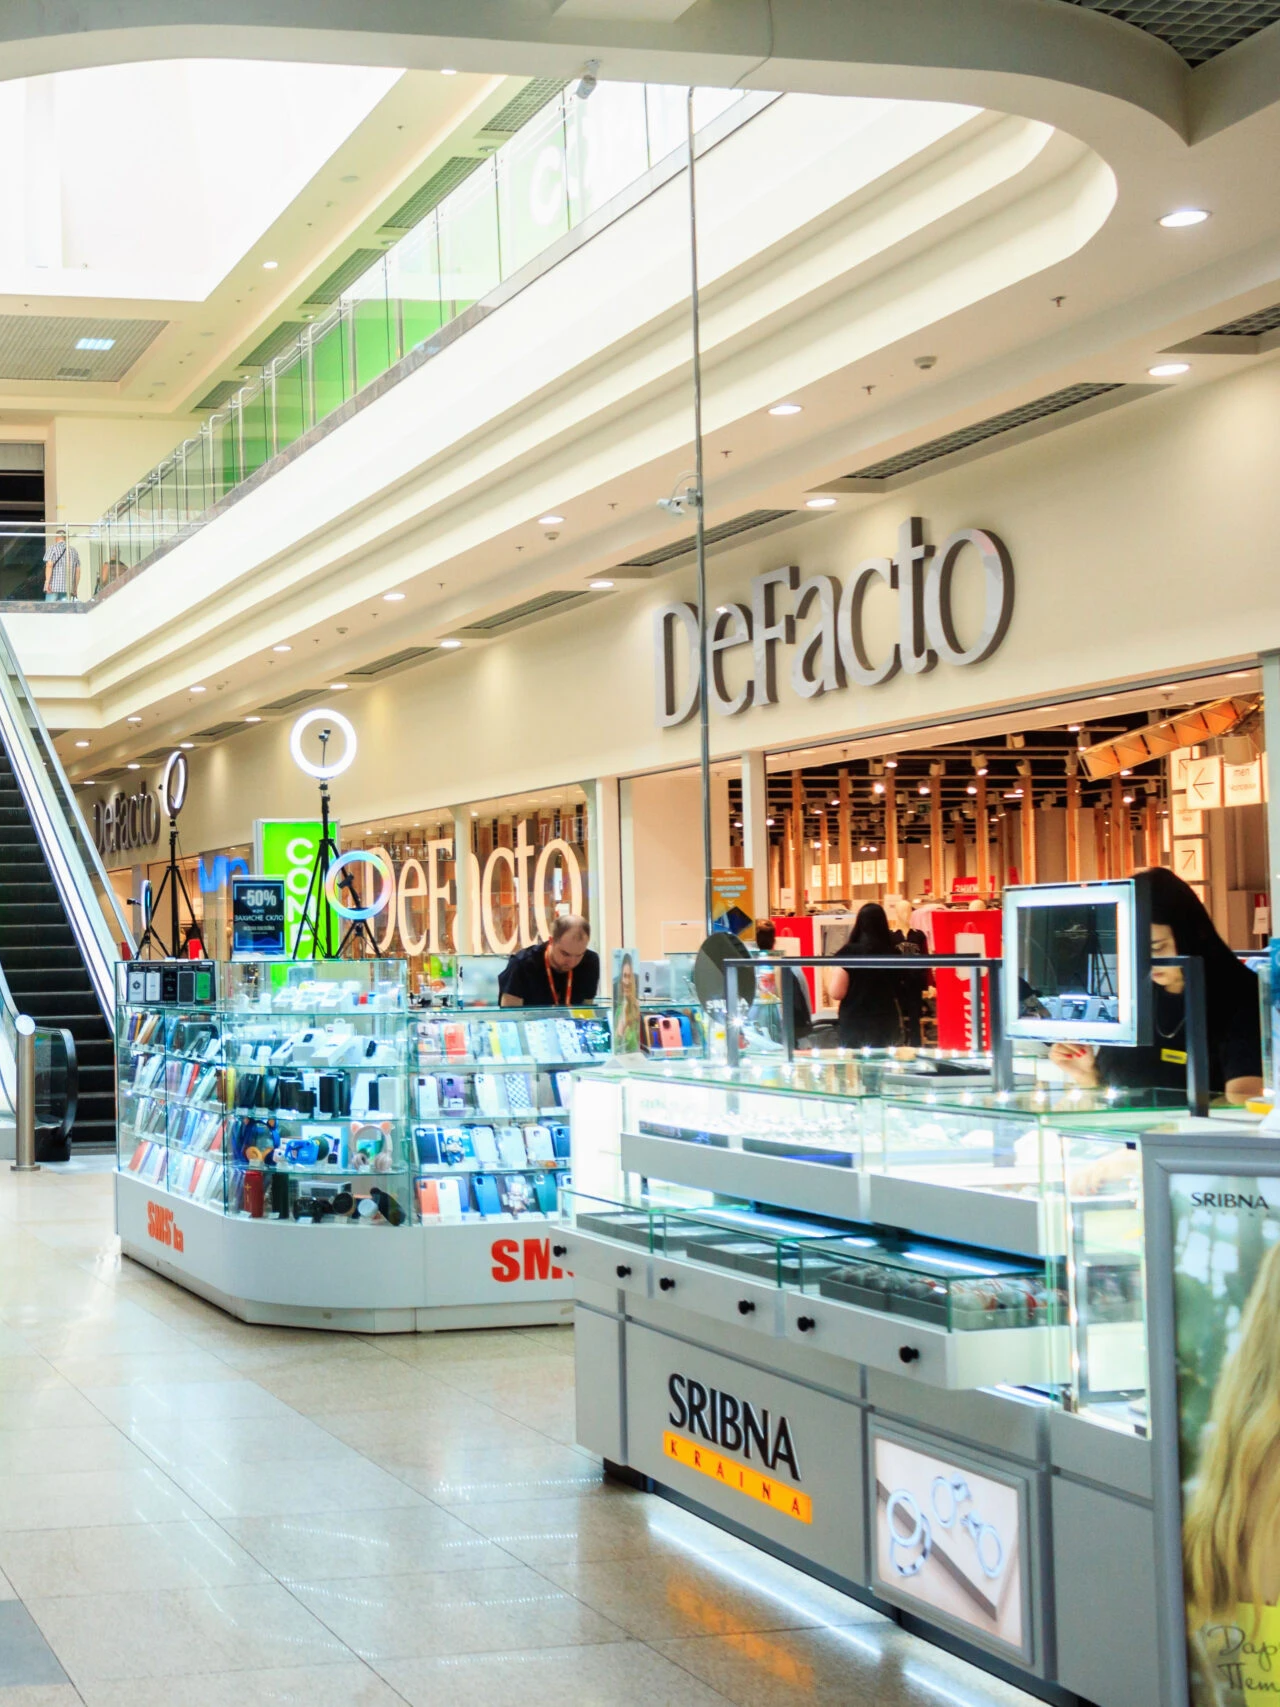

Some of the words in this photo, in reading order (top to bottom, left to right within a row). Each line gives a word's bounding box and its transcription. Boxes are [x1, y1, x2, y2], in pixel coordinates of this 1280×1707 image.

[653, 517, 1015, 727] DeFacto
[235, 914, 263, 922] ЗАХИСНЕ
[265, 914, 284, 922] СКЛО
[241, 889, 277, 907] -50%
[286, 838, 317, 957] COMF
[1191, 1192, 1270, 1209] SRIBNA
[491, 1238, 574, 1283] SM
[669, 1373, 801, 1481] SRIBNA
[671, 1440, 800, 1515] KRAINA
[1207, 1625, 1280, 1672] Дар
